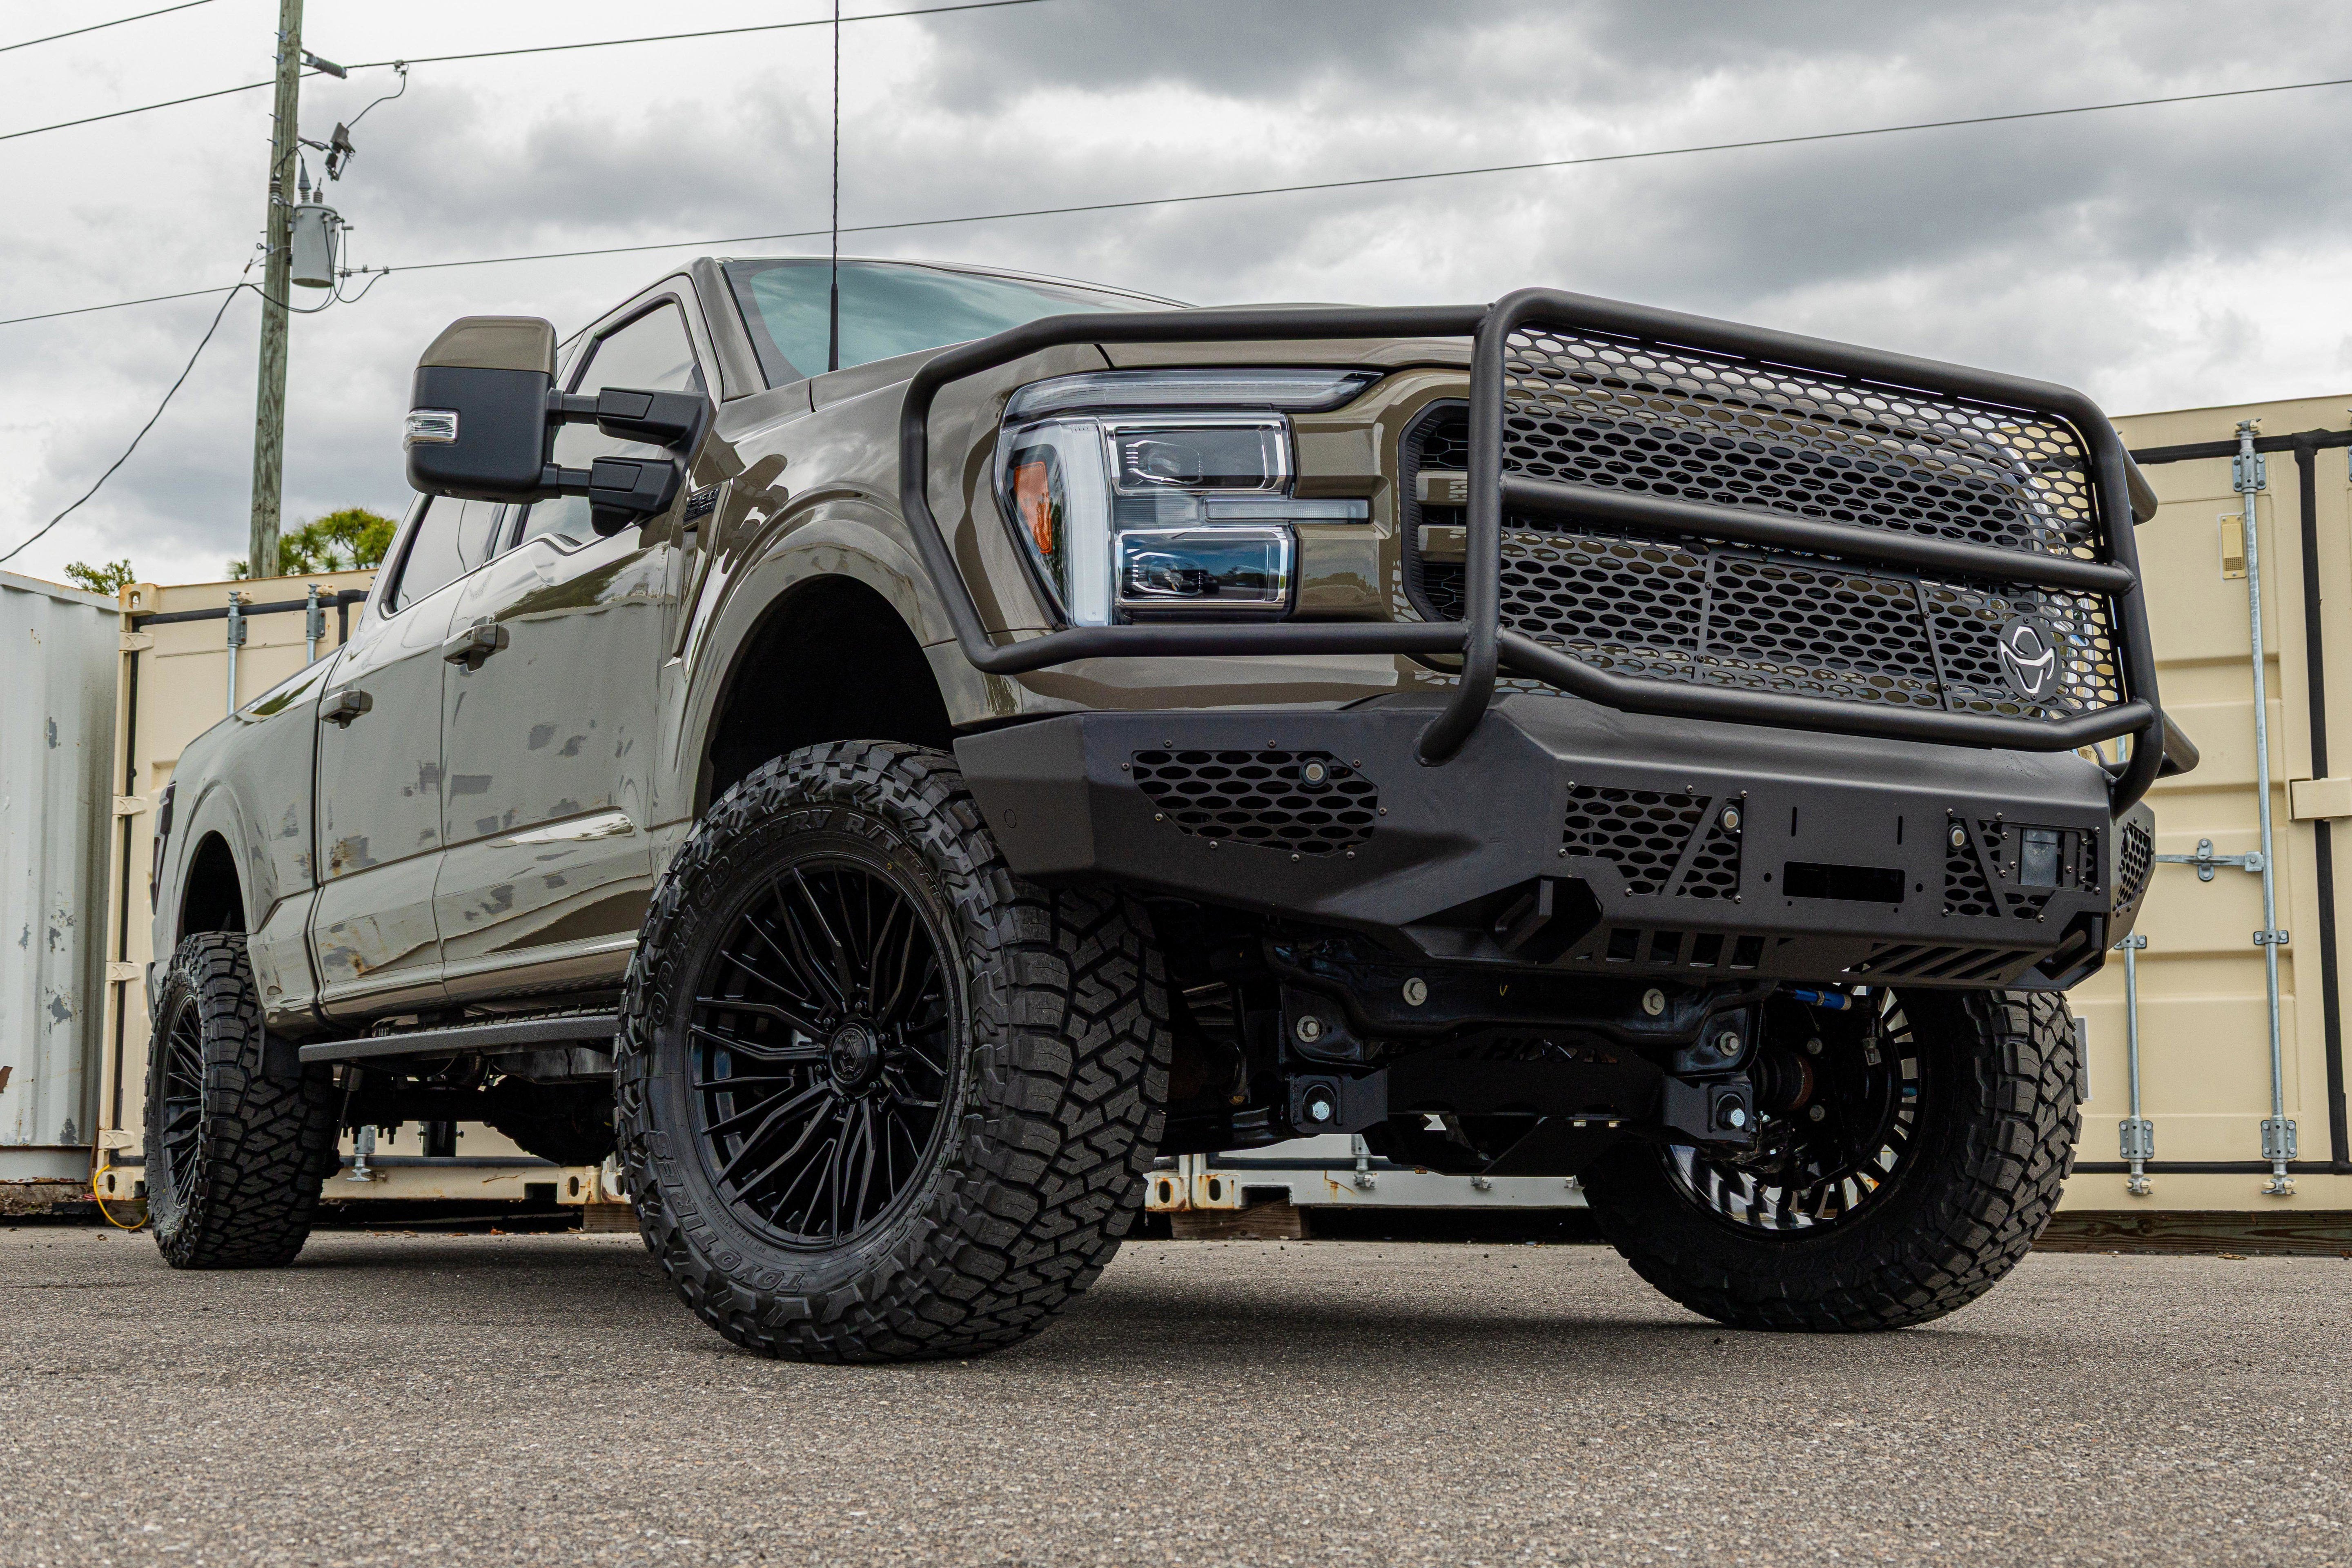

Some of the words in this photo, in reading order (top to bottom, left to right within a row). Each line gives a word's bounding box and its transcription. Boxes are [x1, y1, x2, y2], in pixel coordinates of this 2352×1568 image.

[649, 905, 698, 1027] OPEN
[697, 809, 833, 907] COUNTRY
[844, 812, 902, 852] R/T
[648, 1130, 719, 1254] TIRES
[715, 1249, 805, 1294] TOYO
